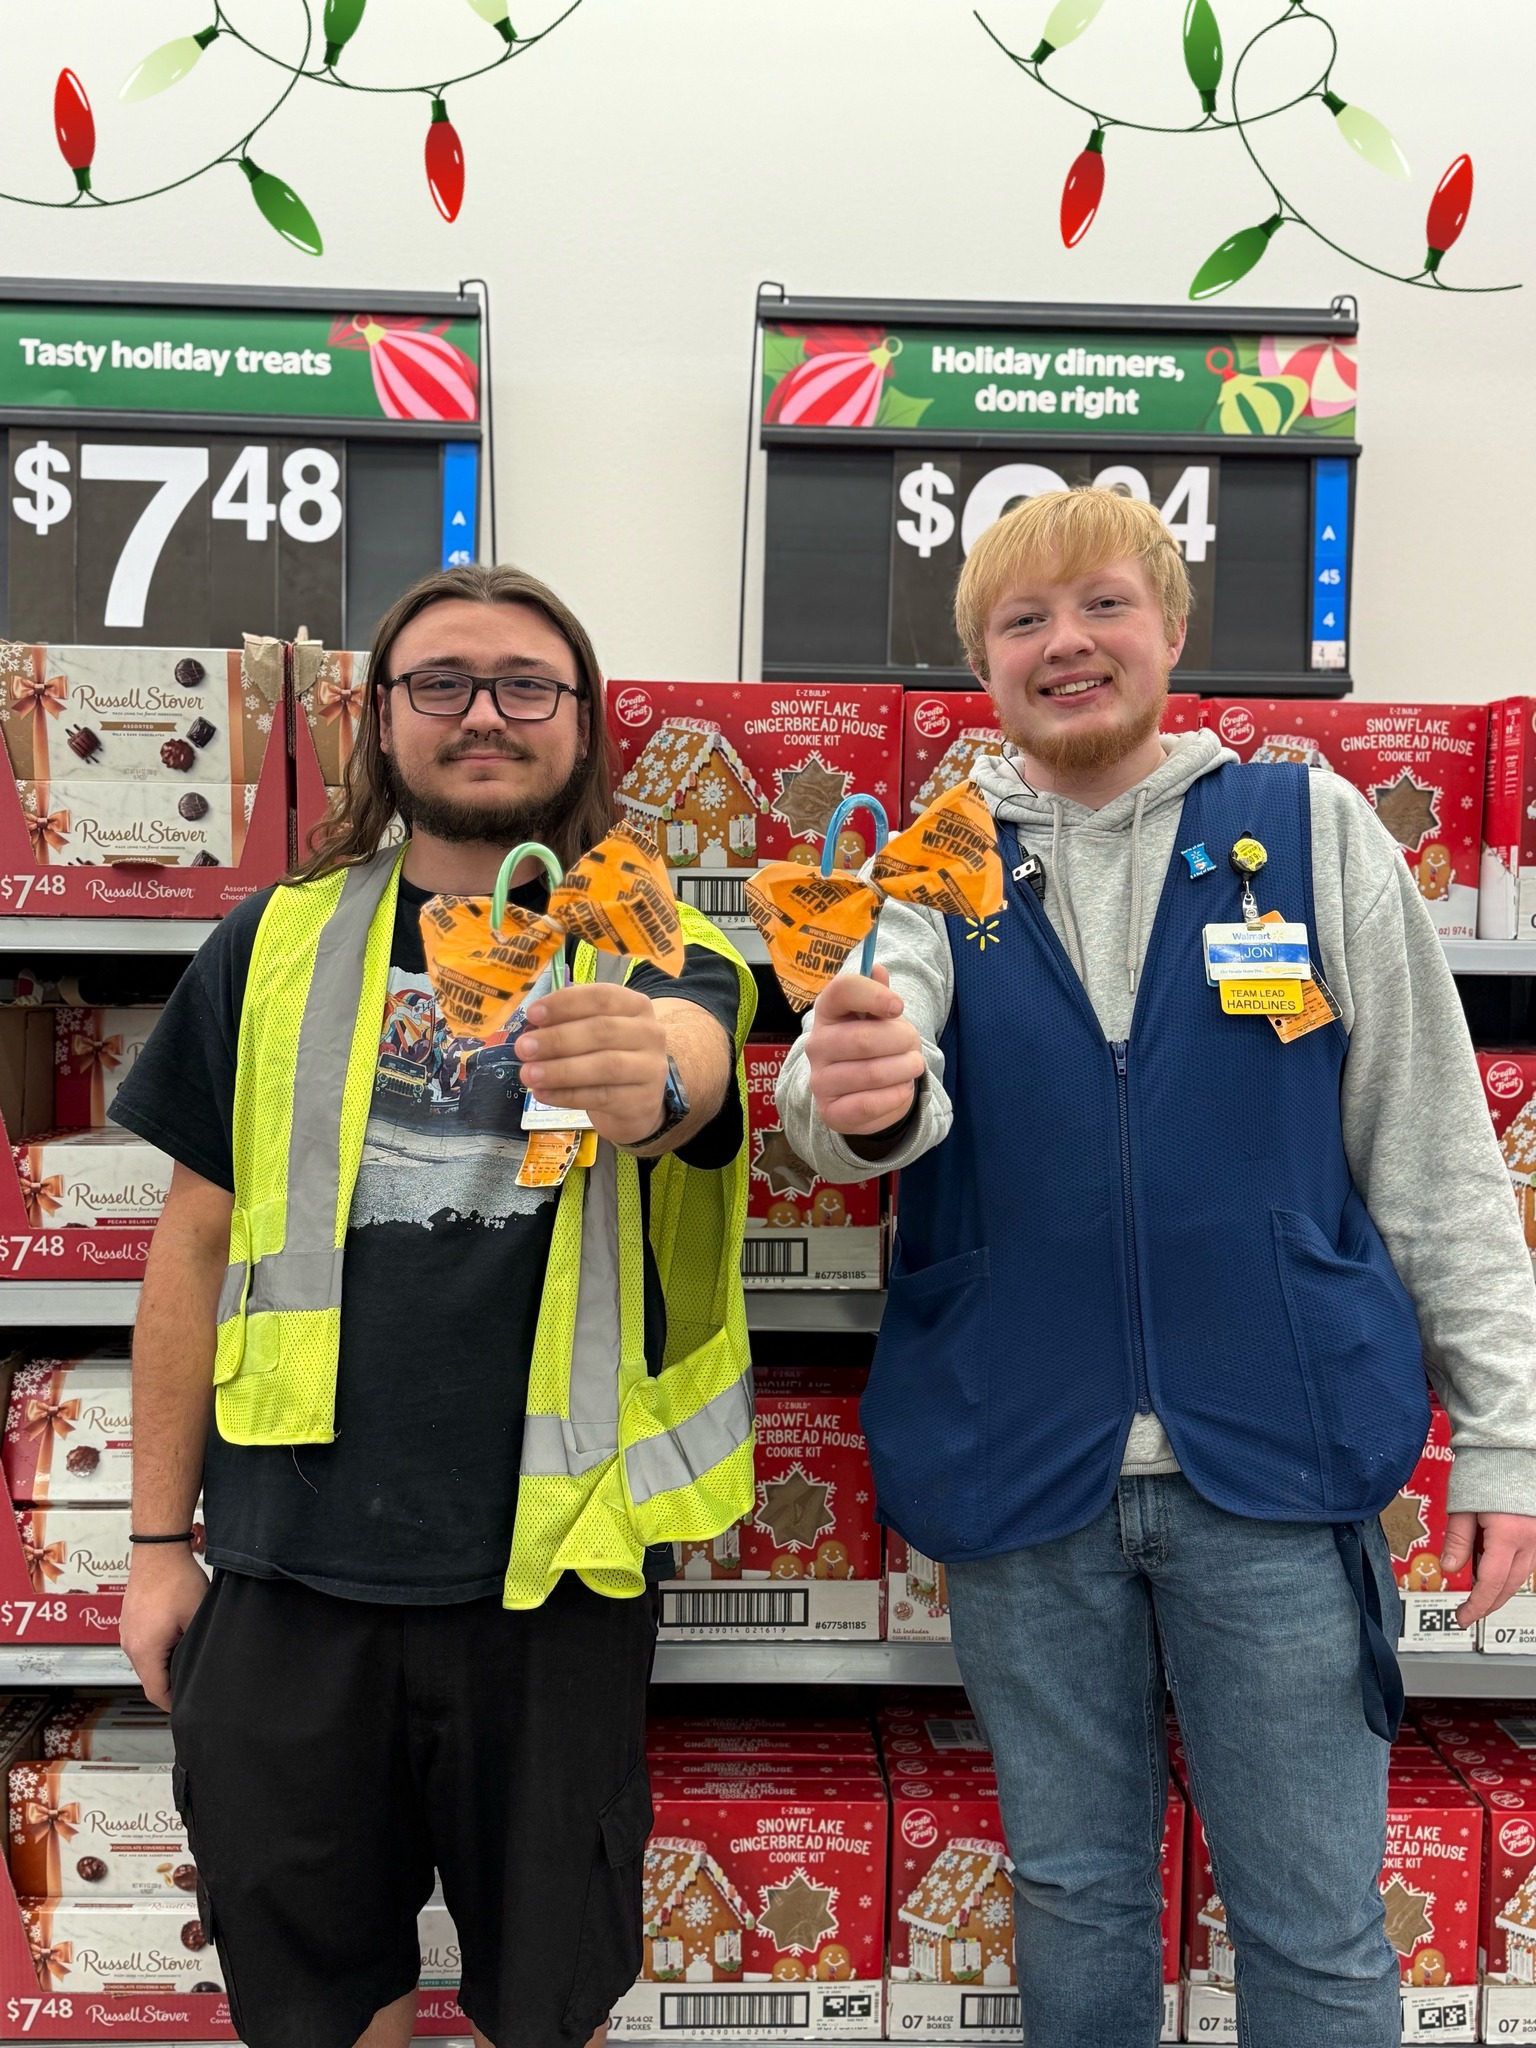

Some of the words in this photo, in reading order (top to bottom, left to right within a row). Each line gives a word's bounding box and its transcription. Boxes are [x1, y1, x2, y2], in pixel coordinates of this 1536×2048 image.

[20, 339, 106, 372] Tasty
[111, 341, 230, 377] holiday
[235, 347, 331, 376] treats
[932, 346, 1050, 380] Holiday
[1053, 349, 1184, 382] dinners,
[975, 384, 1056, 414] done
[1060, 385, 1139, 419] right
[452, 511, 466, 526] A
[1321, 525, 1336, 541] A
[1318, 569, 1341, 585] 45
[1322, 612, 1336, 627] 4
[72, 684, 146, 714] Russell
[146, 686, 204, 711] Stover
[618, 695, 646, 710] Create
[624, 705, 650, 721] Treat
[771, 701, 861, 718] SNOWFLAKE
[917, 706, 943, 721] Create
[744, 717, 837, 735] GINGERBREAD
[841, 719, 888, 739] HOUSE
[923, 716, 946, 733] Treat
[1222, 713, 1248, 727] Create
[1366, 718, 1450, 735] SNOWFLAKE
[1228, 724, 1250, 739] Treat
[784, 734, 822, 746] COOKIE
[824, 735, 841, 746] KIT
[1341, 734, 1429, 752] GINGERBREAD
[1432, 736, 1475, 756] HOUSE
[1378, 751, 1413, 762] COOKIE
[1415, 751, 1432, 762] KIT
[75, 819, 148, 850] Russell
[148, 820, 207, 843] Stover
[935, 818, 991, 856] CAUTION
[921, 829, 949, 850] WET
[946, 840, 987, 873] FLOOR!
[86, 880, 146, 903] Russell
[146, 880, 194, 900] Stover
[791, 884, 819, 904] WET
[808, 882, 840, 906] CAUT
[630, 899, 676, 957] MOJADO!
[1232, 932, 1270, 940] Walmart
[1439, 926, 1450, 936] oz)
[1453, 927, 1466, 935] 974
[1469, 928, 1474, 937] g
[795, 950, 821, 971] PISO
[1244, 947, 1273, 958] JON
[1260, 990, 1285, 998] LEAD
[1227, 1000, 1296, 1011] HARDLINES
[1490, 1067, 1517, 1082] Create
[1496, 1077, 1521, 1092] Treat
[68, 1183, 139, 1210] Russell
[77, 1241, 133, 1264] Russell
[815, 1271, 866, 1280] #677581185
[754, 1412, 841, 1430] SNOWFLAKE
[822, 1431, 866, 1450] HOUSE
[766, 1446, 803, 1458] COOKIE
[805, 1446, 823, 1458] KIT
[814, 1621, 867, 1631] #677581185
[1495, 1629, 1517, 1643] 07
[84, 1810, 152, 1837] Russell
[756, 1818, 845, 1836] SNOWFLAKE
[904, 1815, 931, 1830] Create
[910, 1826, 933, 1842] Treat
[1387, 1825, 1442, 1841] WFLAKE
[1502, 1825, 1529, 1840] Create
[730, 1834, 823, 1854] GINGERBREAD
[826, 1837, 872, 1855] HOUSE
[1423, 1842, 1468, 1861] HOUSE
[1508, 1836, 1531, 1852] Treat
[769, 1852, 807, 1863] COOKIE
[809, 1852, 825, 1863] KIT
[1406, 1858, 1422, 1868] KIT
[77, 1949, 143, 1977] Russell
[146, 1950, 202, 1972] Stover
[7, 1998, 73, 2031] $748
[86, 2005, 143, 2026] Russell
[143, 2005, 189, 2023] Stover
[902, 2015, 923, 2029] 07
[1199, 2017, 1221, 2031] 07
[1499, 2019, 1520, 2033] 07
